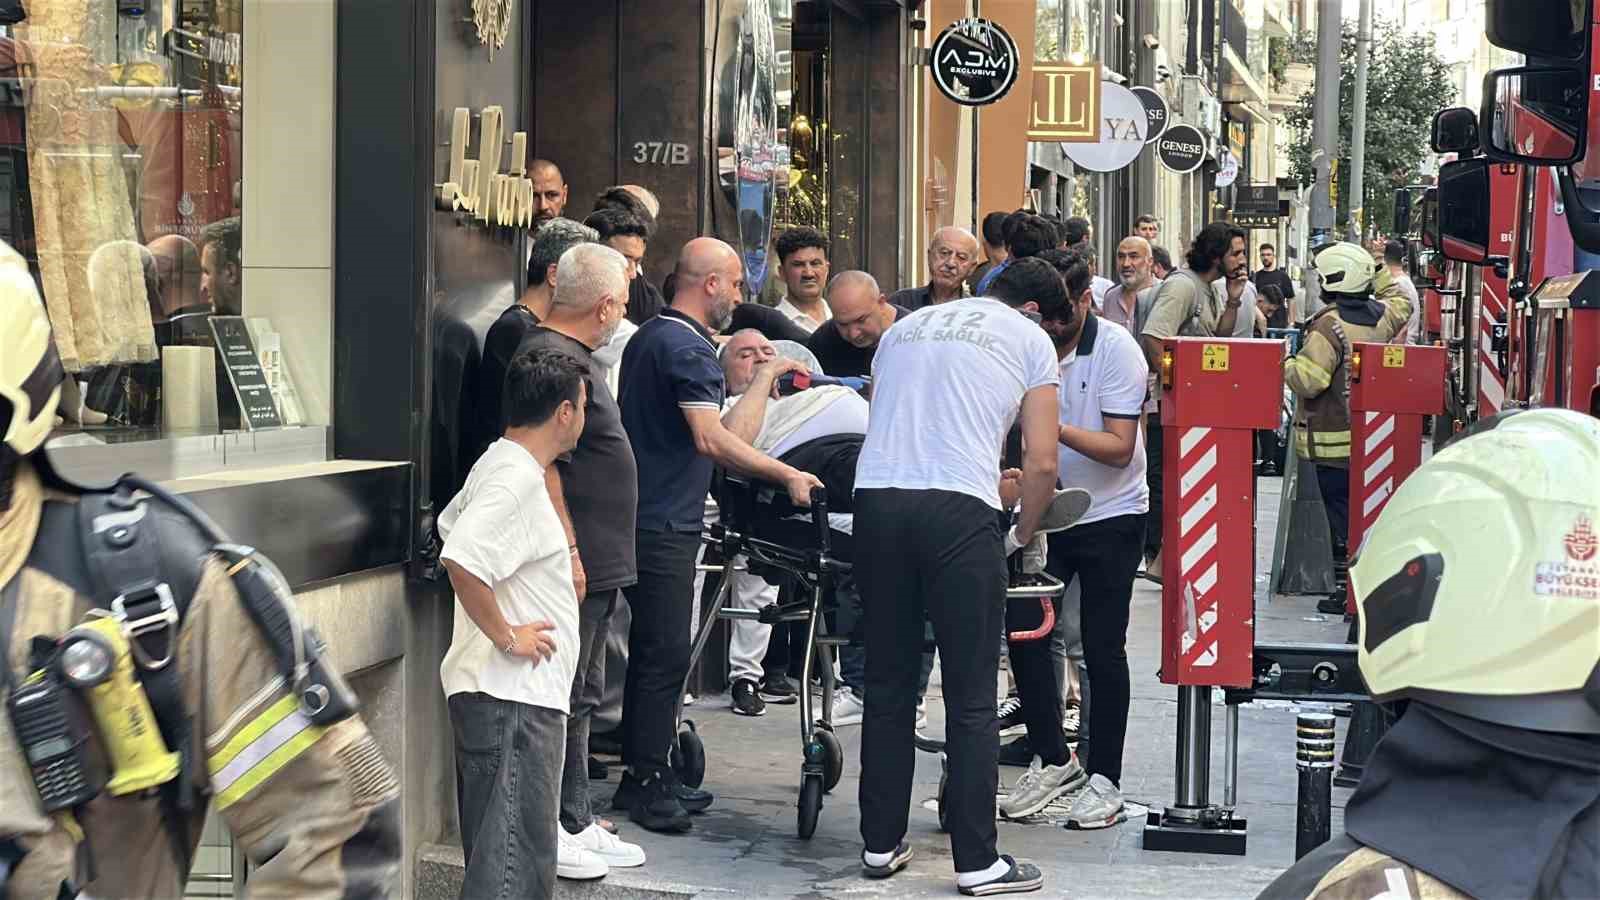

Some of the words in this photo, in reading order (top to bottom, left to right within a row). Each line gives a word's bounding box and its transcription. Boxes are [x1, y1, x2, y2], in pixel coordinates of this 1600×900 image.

[950, 66, 997, 77] EXCLUSIVE
[633, 141, 689, 165] 37/B
[1161, 140, 1202, 154] GENESE
[919, 310, 986, 329] 112
